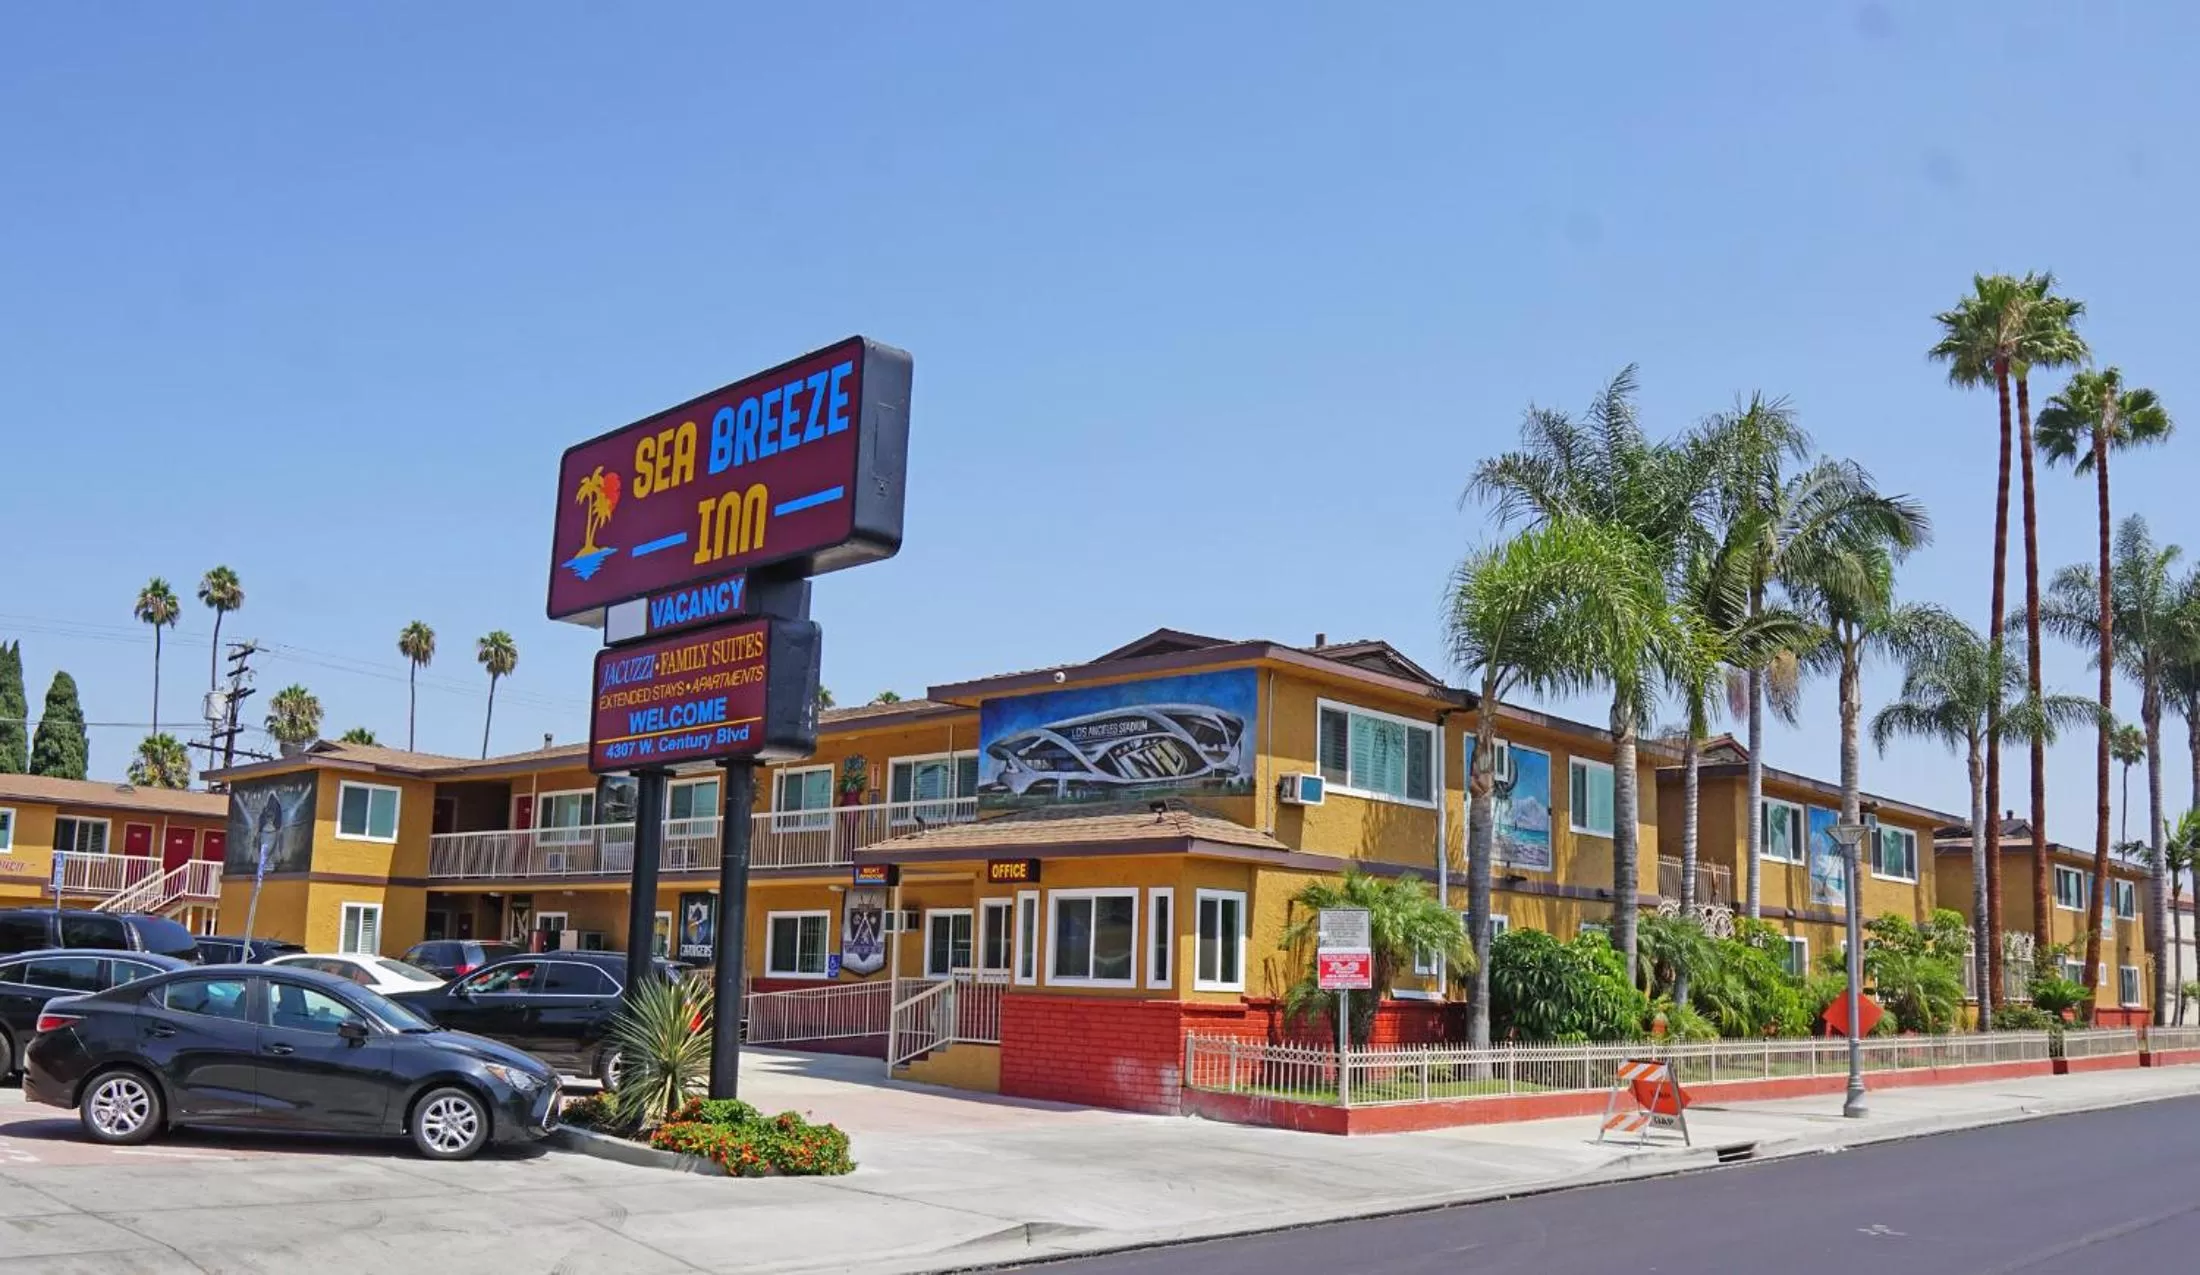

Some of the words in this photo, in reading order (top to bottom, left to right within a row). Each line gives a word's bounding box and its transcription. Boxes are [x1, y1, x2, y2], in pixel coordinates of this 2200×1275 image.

[632, 421, 697, 500] SEA
[708, 360, 853, 475] BREEZE
[694, 483, 768, 565] INN
[651, 578, 745, 629] VACANCY
[601, 653, 656, 694] JACUZZI
[660, 643, 710, 676] FAMILY
[712, 631, 764, 667] SUITES
[600, 687, 651, 710] EXTENDED
[652, 680, 685, 700] STAYS
[691, 665, 765, 692] APARTMENTS
[629, 696, 728, 734] WELCOME
[606, 741, 635, 760] 4307
[659, 731, 712, 753] Century
[716, 724, 749, 745] Blvd
[992, 863, 1027, 879] OFFICE
